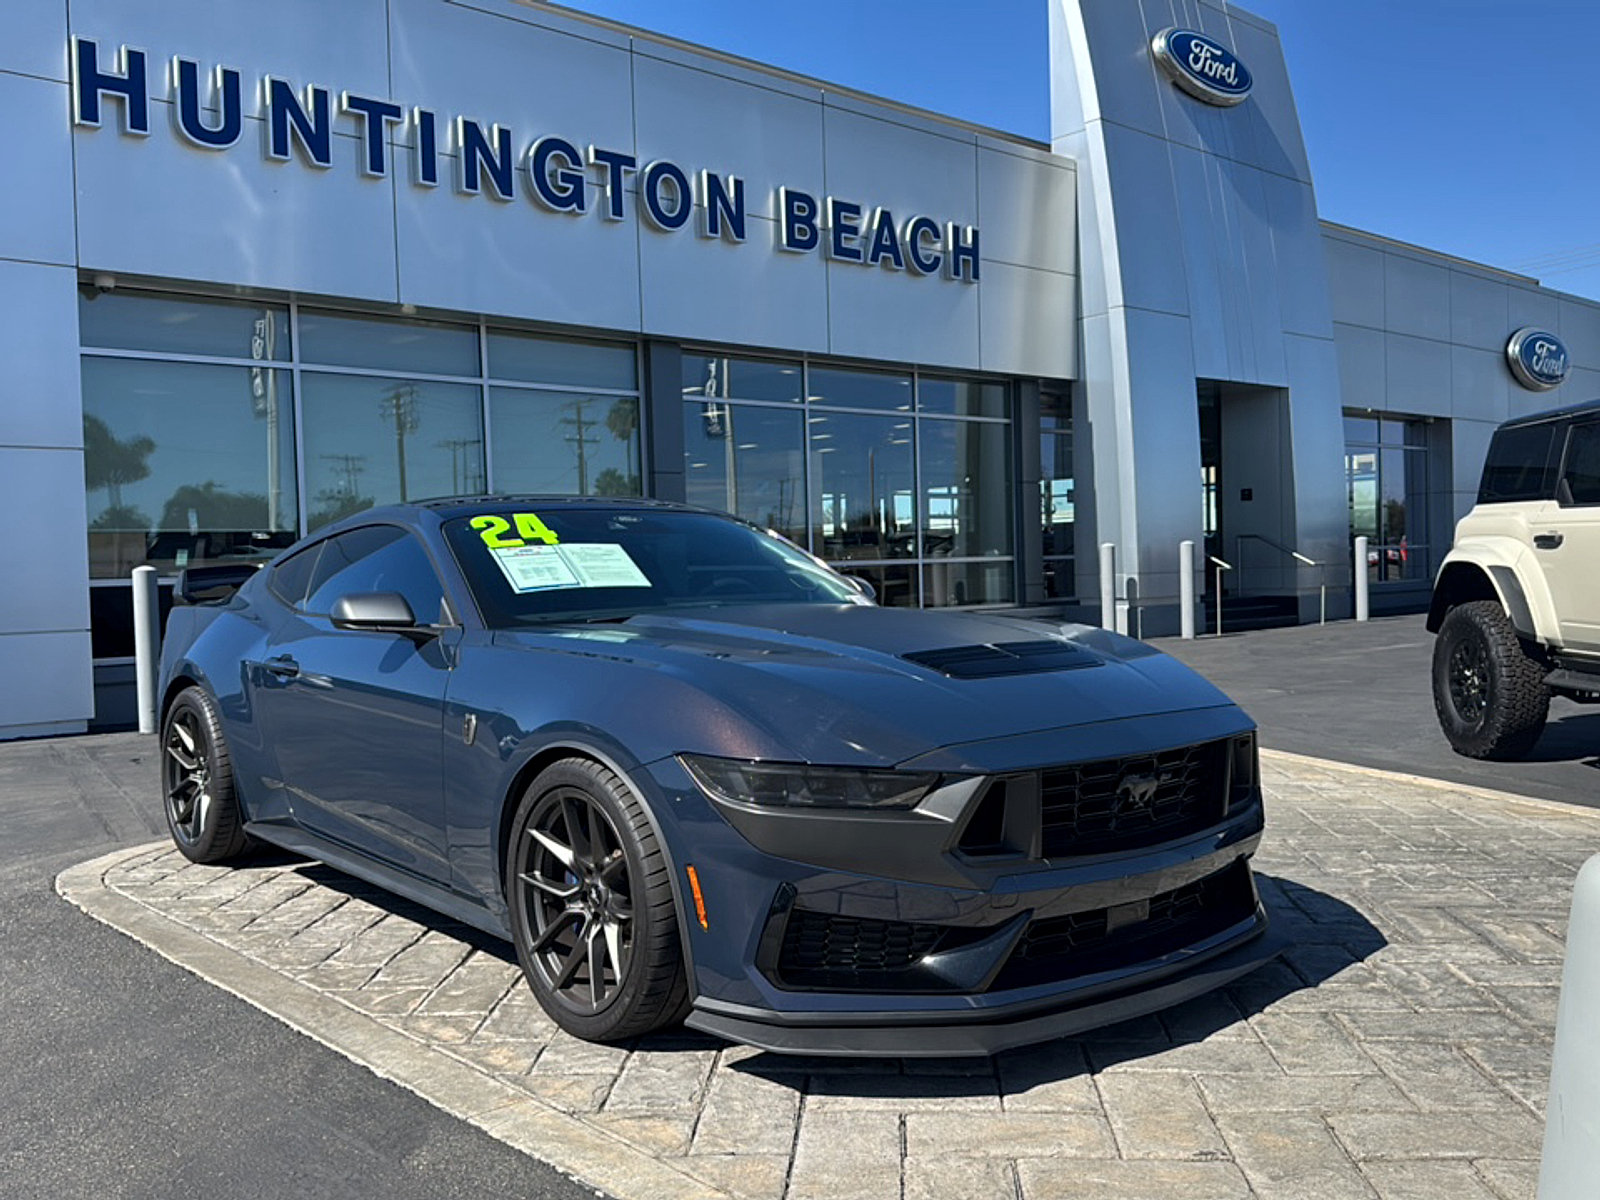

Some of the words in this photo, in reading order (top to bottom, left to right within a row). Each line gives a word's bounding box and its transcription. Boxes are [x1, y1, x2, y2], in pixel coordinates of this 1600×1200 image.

[1188, 39, 1238, 86] Ford
[73, 35, 746, 242] HUNTINGTON
[780, 187, 980, 281] BEACH
[1532, 340, 1565, 376] Ford
[469, 513, 559, 549] 24
